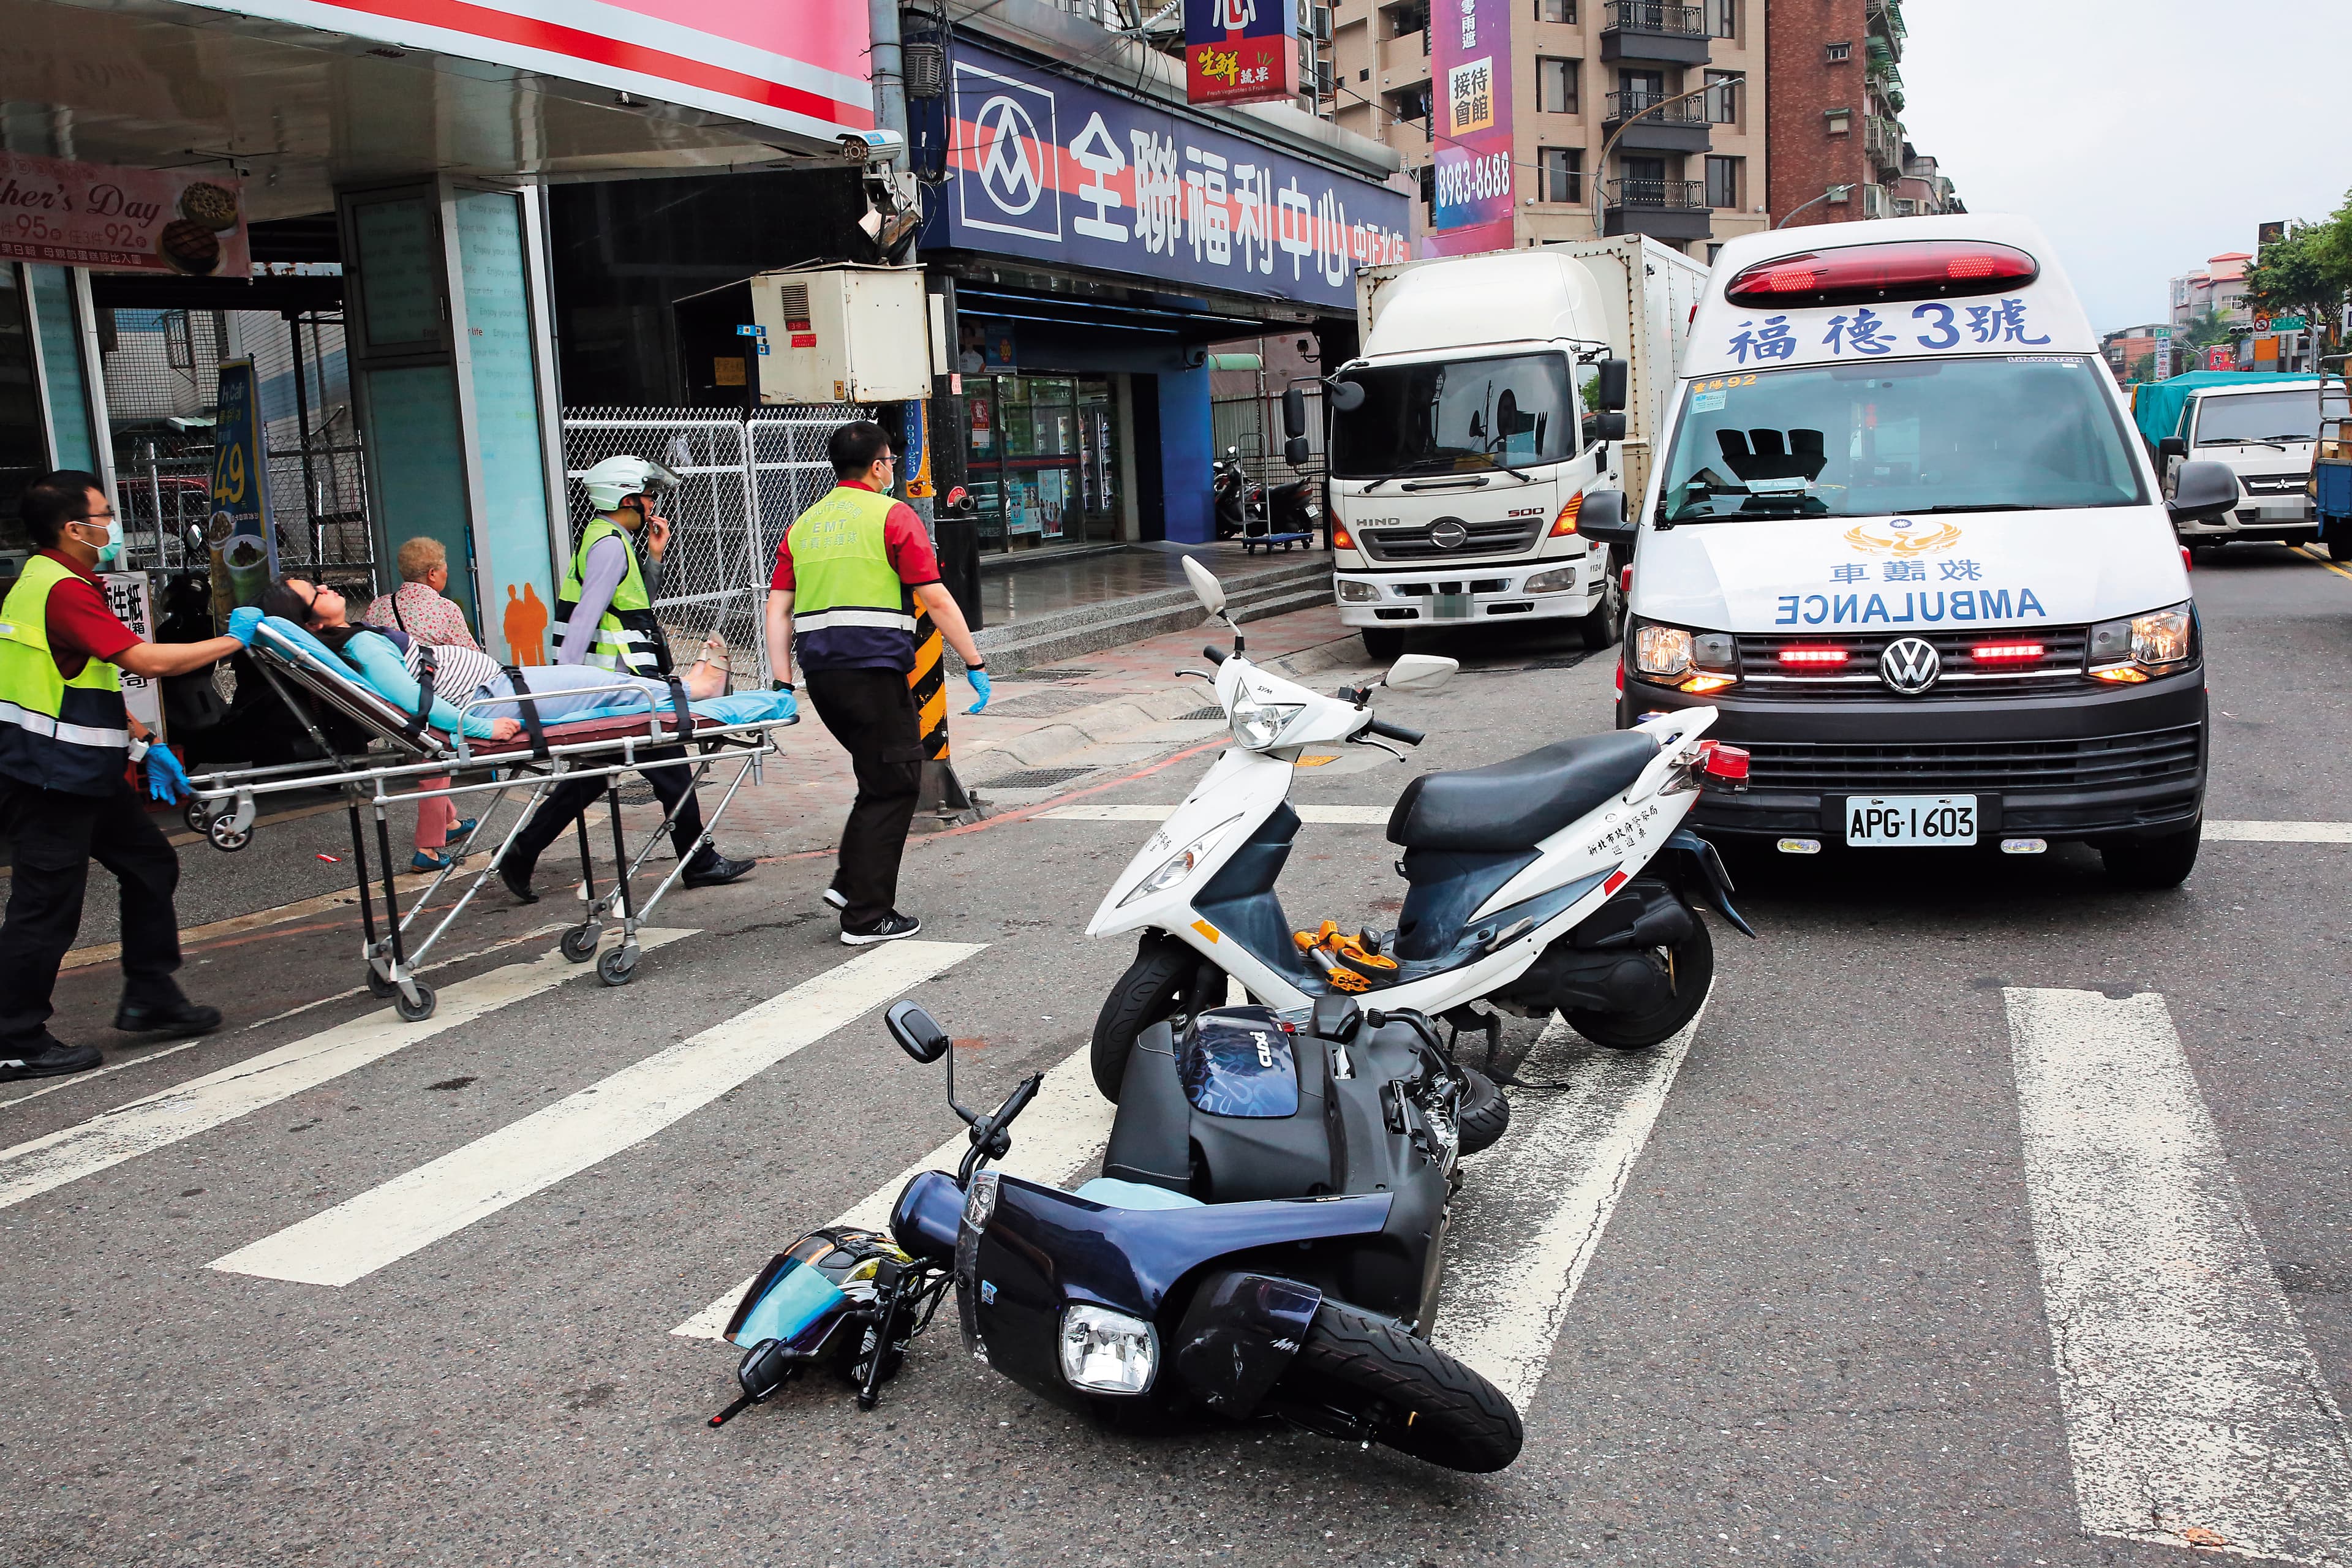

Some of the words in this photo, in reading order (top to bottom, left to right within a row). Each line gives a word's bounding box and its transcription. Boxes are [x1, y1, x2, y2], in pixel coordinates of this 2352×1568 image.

[1197, 45, 1240, 86] 生鮮
[1240, 66, 1269, 85] 蔬果
[1221, 87, 1248, 96] Vegetables
[1453, 67, 1488, 100] 接待
[1454, 94, 1489, 128] 會館
[1438, 150, 1510, 209] 8983-8688
[86, 184, 162, 228] Day
[1069, 111, 1350, 288] 全聯福利中心
[1353, 218, 1404, 266] 中正北店
[472, 327, 483, 336] life
[1725, 298, 2051, 364] 福德3號
[213, 441, 245, 507] 49
[813, 519, 847, 533] EMT
[1356, 518, 1400, 527] HINO
[1508, 507, 1544, 518] 500
[1589, 563, 1602, 573] 1124
[1257, 685, 1273, 695] SYM
[1588, 805, 1659, 856] 新北市政府警察局
[1850, 807, 1974, 838] APG-1603
